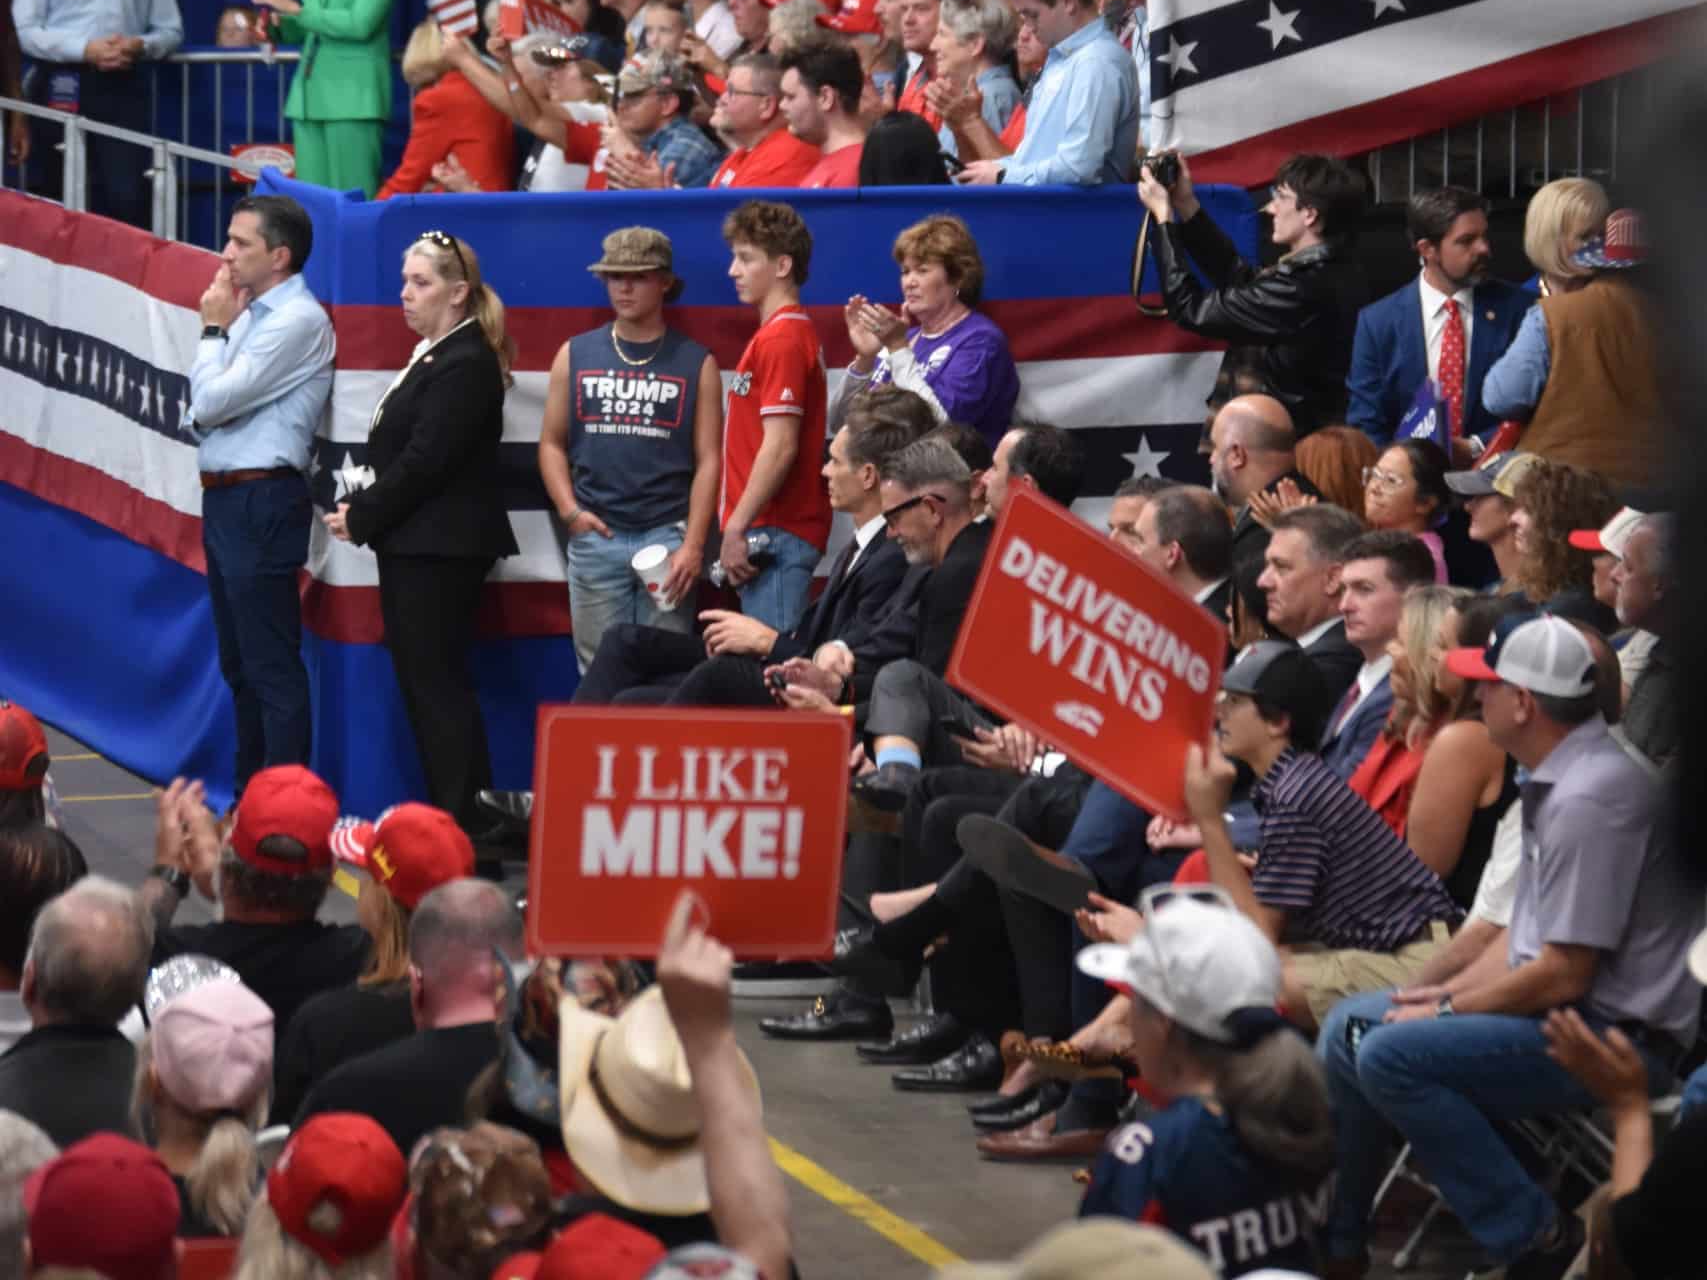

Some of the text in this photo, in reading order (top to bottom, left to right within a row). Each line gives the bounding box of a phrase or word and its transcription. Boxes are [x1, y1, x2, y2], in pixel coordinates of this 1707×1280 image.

[582, 376, 679, 404] TRUMP
[601, 399, 655, 417] 2024
[1000, 537, 1211, 693] DELIVERING
[1028, 600, 1167, 722] WINS
[595, 744, 789, 803] I LIKE
[580, 804, 804, 880] MIKE!
